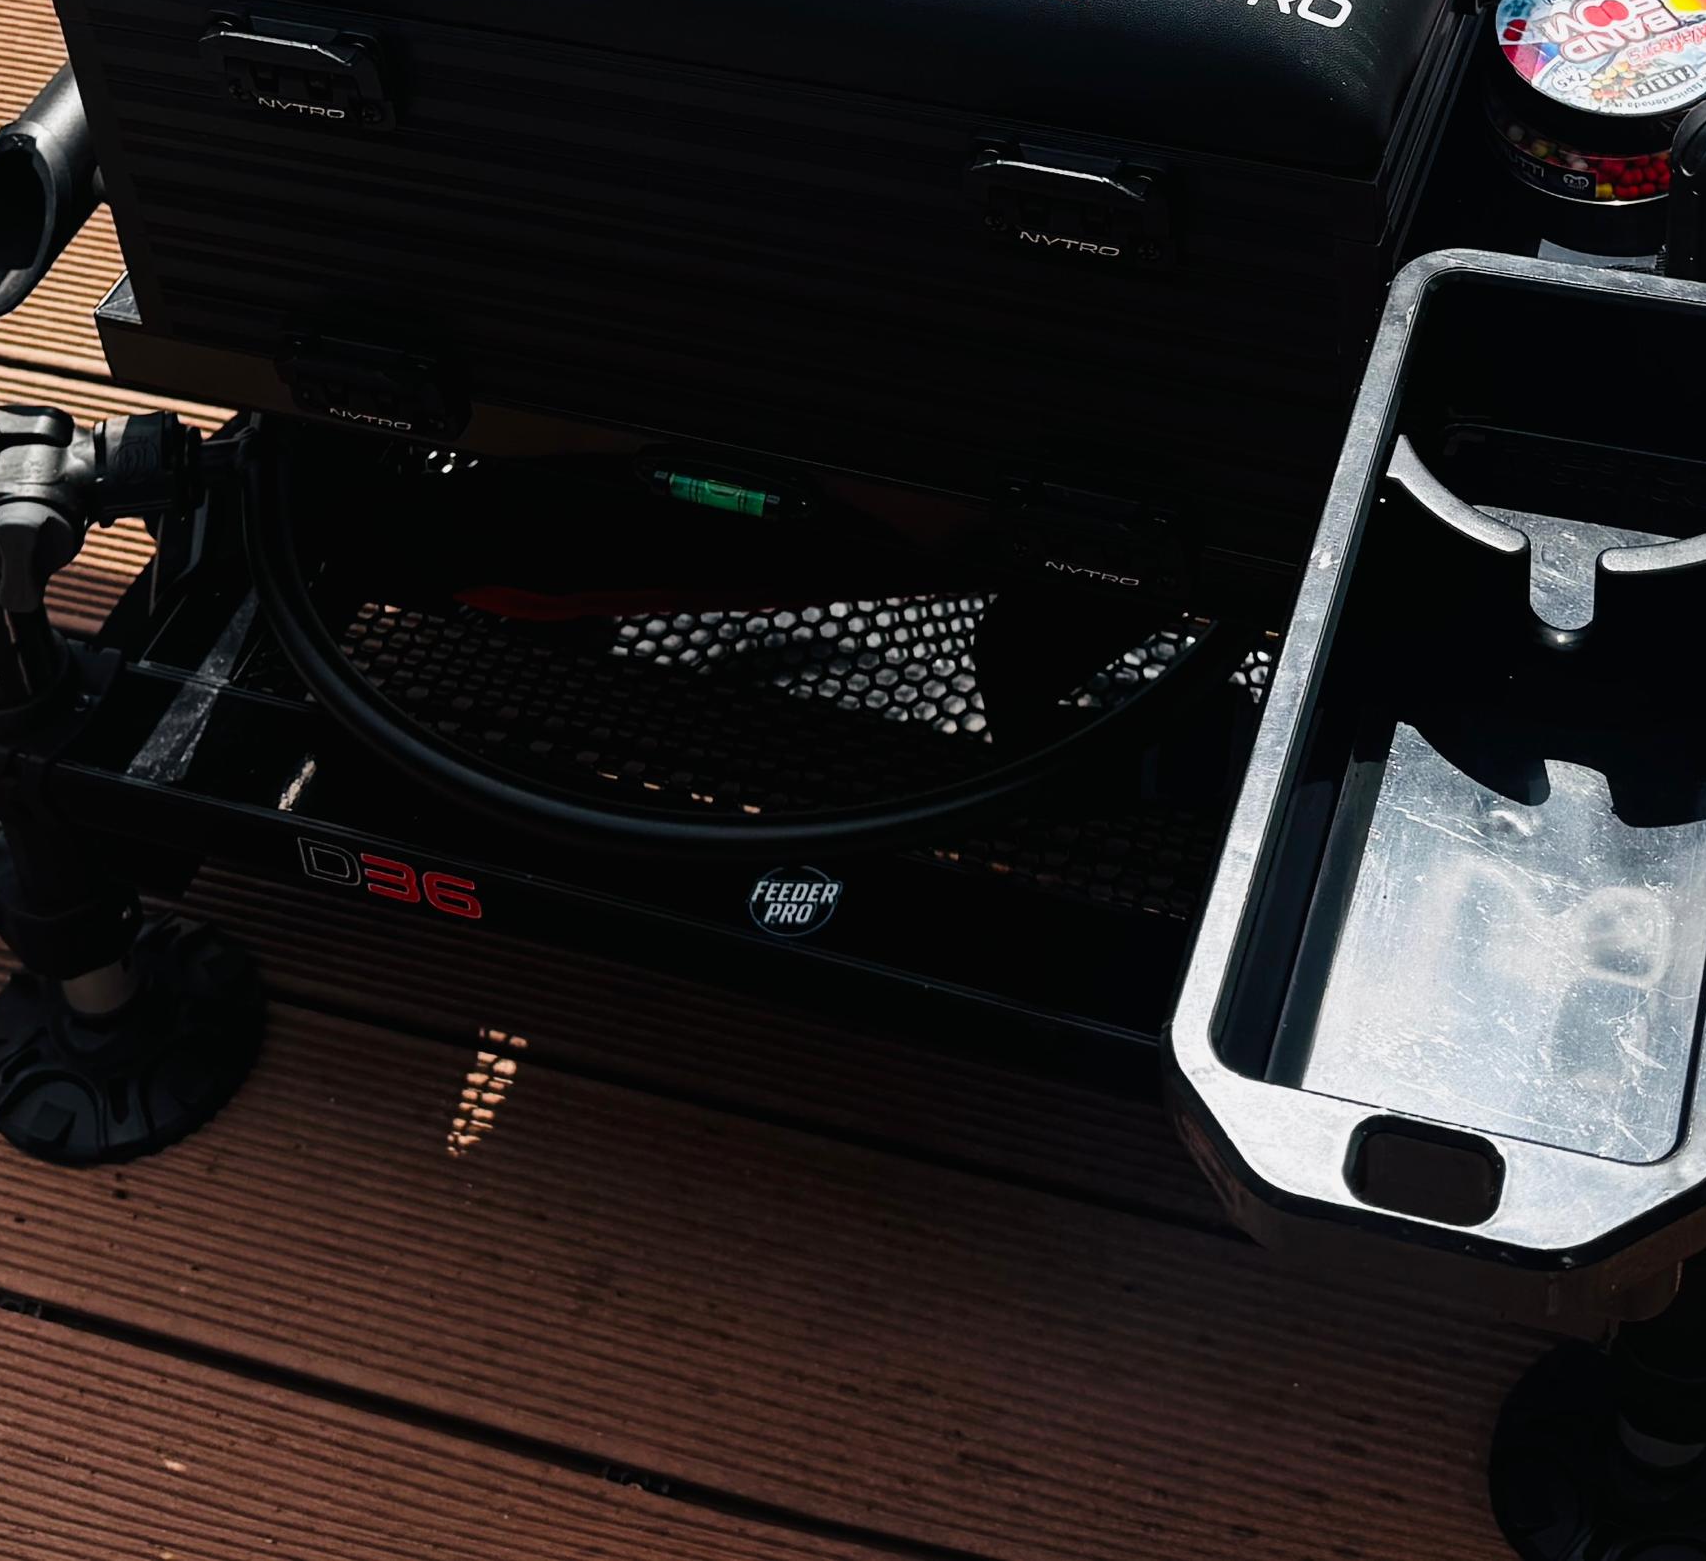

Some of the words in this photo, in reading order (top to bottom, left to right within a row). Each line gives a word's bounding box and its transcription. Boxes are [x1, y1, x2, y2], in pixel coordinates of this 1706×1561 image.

[1561, 5, 1681, 64] BAND
[258, 95, 346, 120] NYTRO
[1020, 231, 1120, 257] NYTRO
[329, 407, 412, 431] NYTRO
[1045, 560, 1140, 586] NYTRO
[297, 836, 483, 919] D36
[750, 880, 840, 904] FEEDER
[763, 903, 814, 924] PRO
